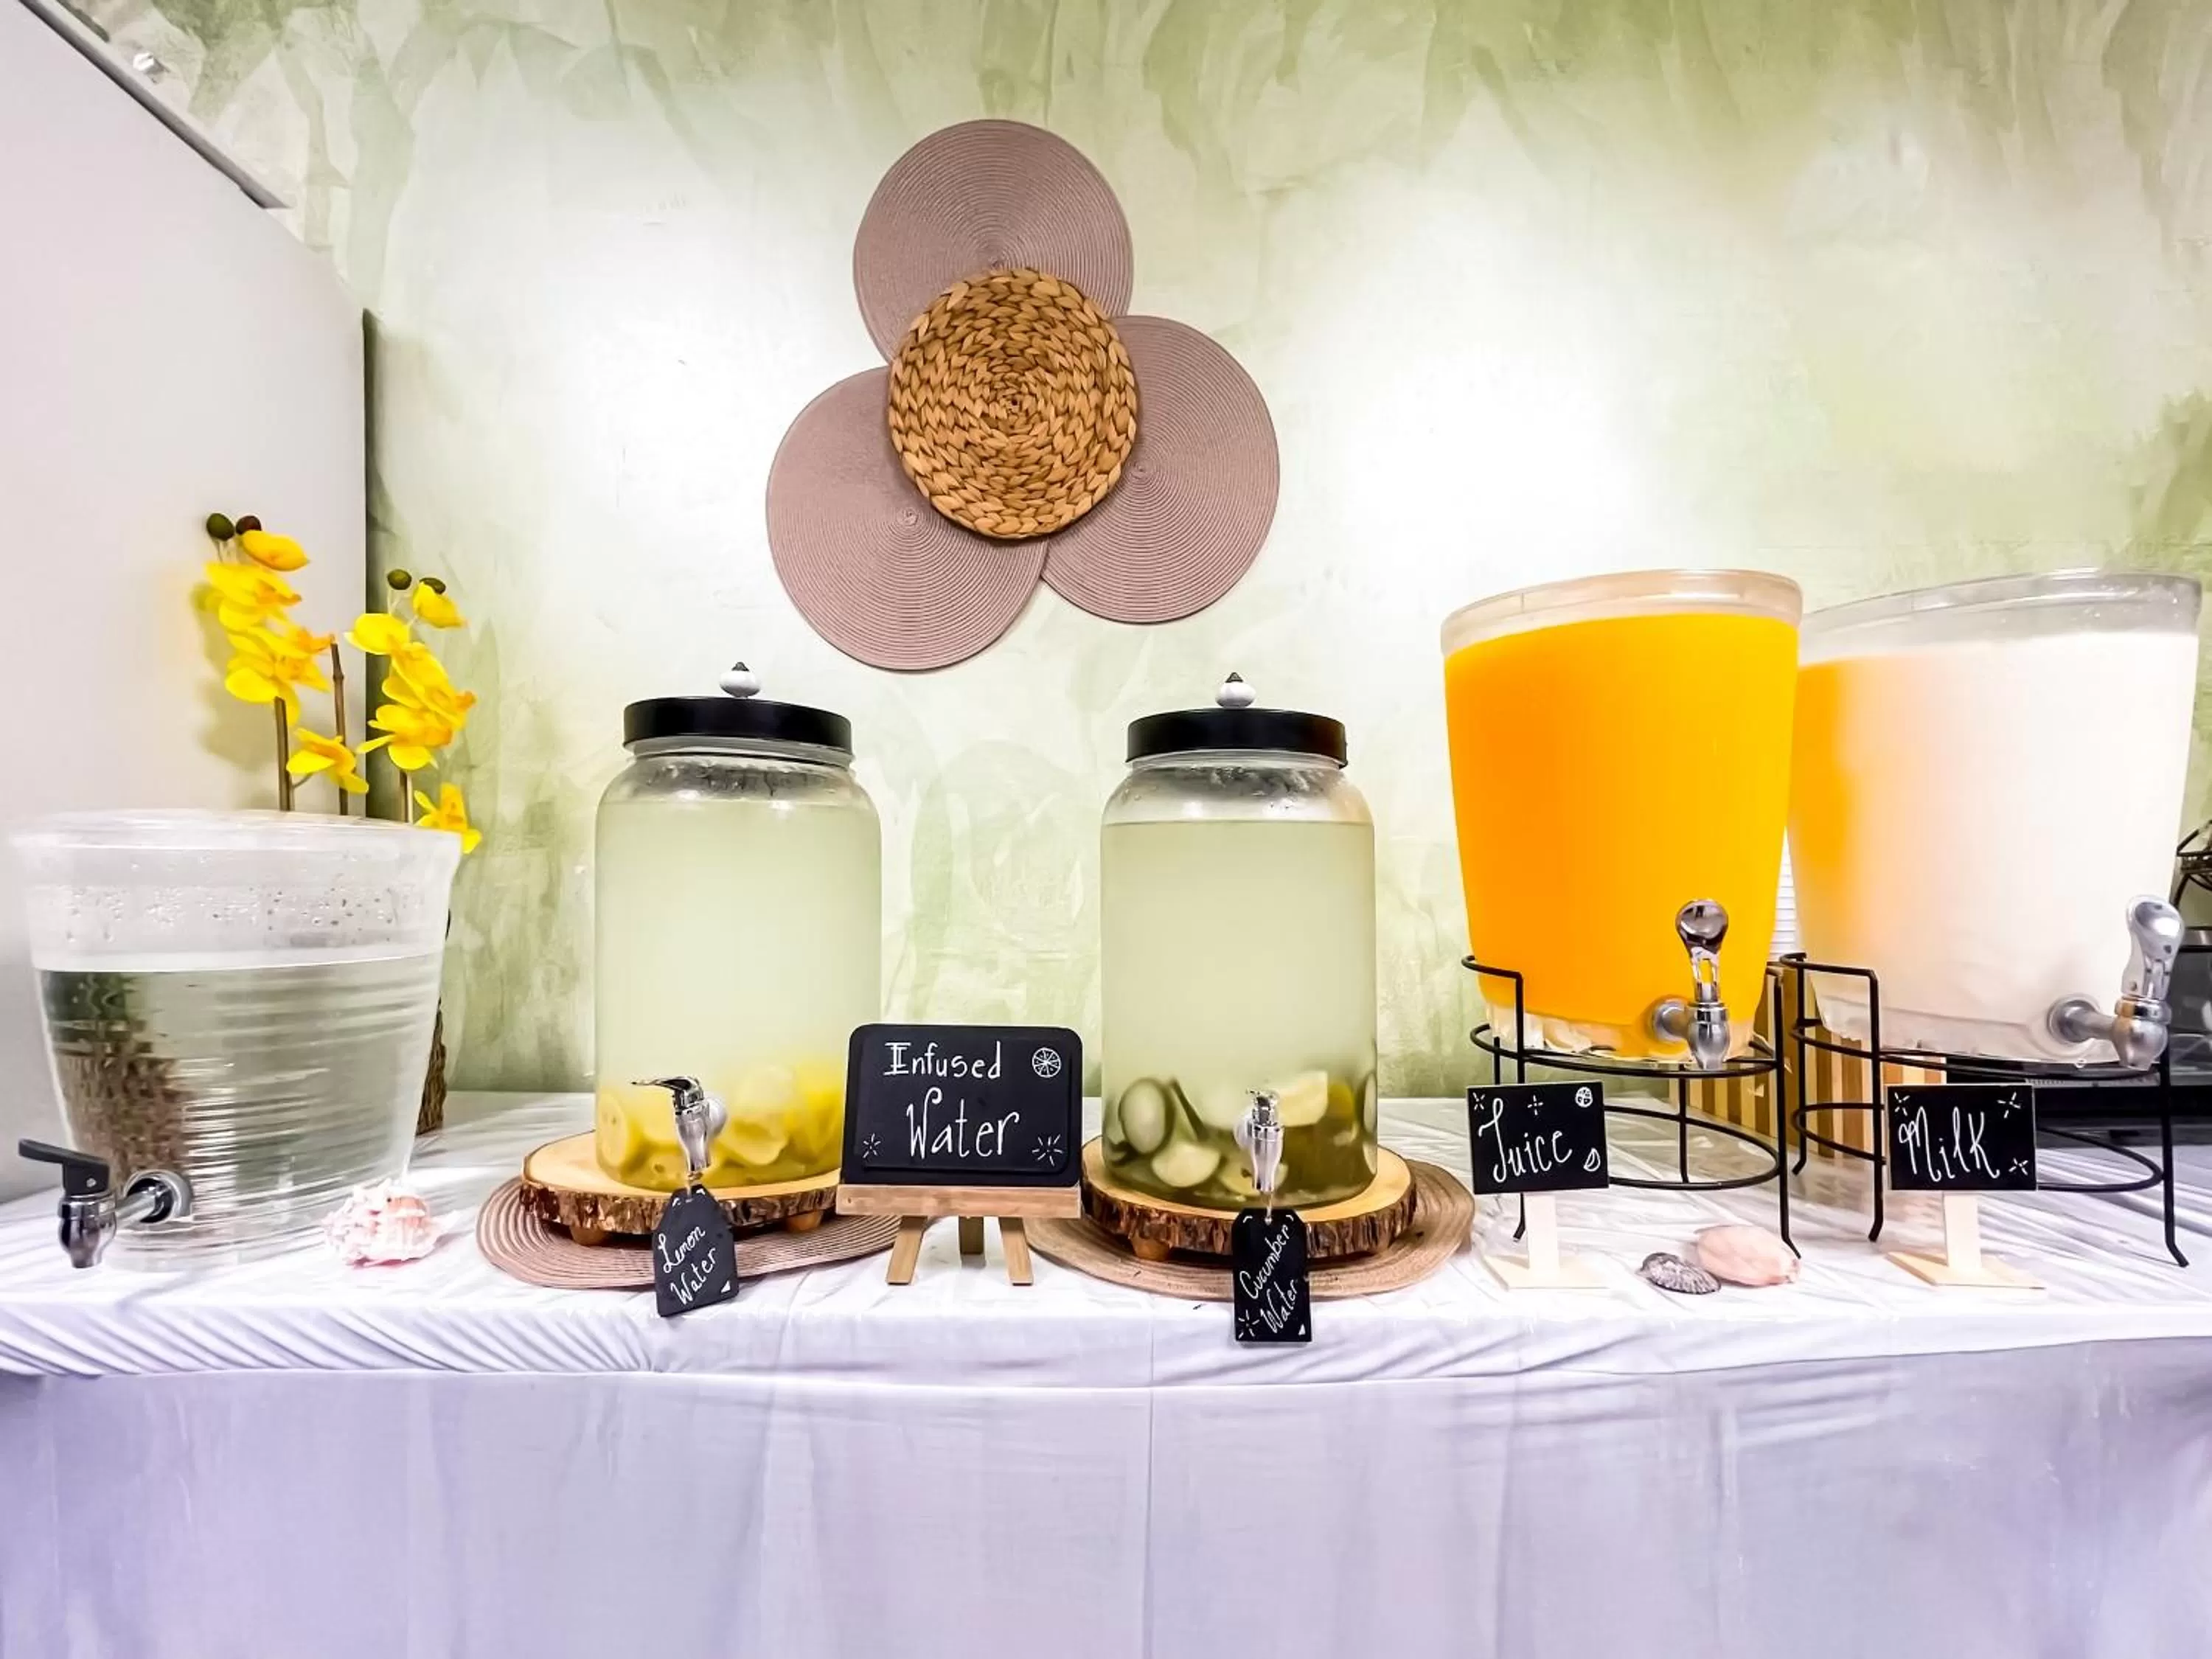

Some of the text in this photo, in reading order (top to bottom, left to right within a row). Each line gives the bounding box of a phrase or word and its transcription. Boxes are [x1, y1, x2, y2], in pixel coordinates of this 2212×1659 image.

[883, 1040, 1001, 1079] Infused
[906, 1087, 1020, 1160] Water
[1478, 1097, 1573, 1183] Juice
[658, 1226, 706, 1273] Lemon
[670, 1247, 716, 1305] Water
[1239, 1224, 1290, 1300] Cucumber
[1260, 1279, 1298, 1334] Water
